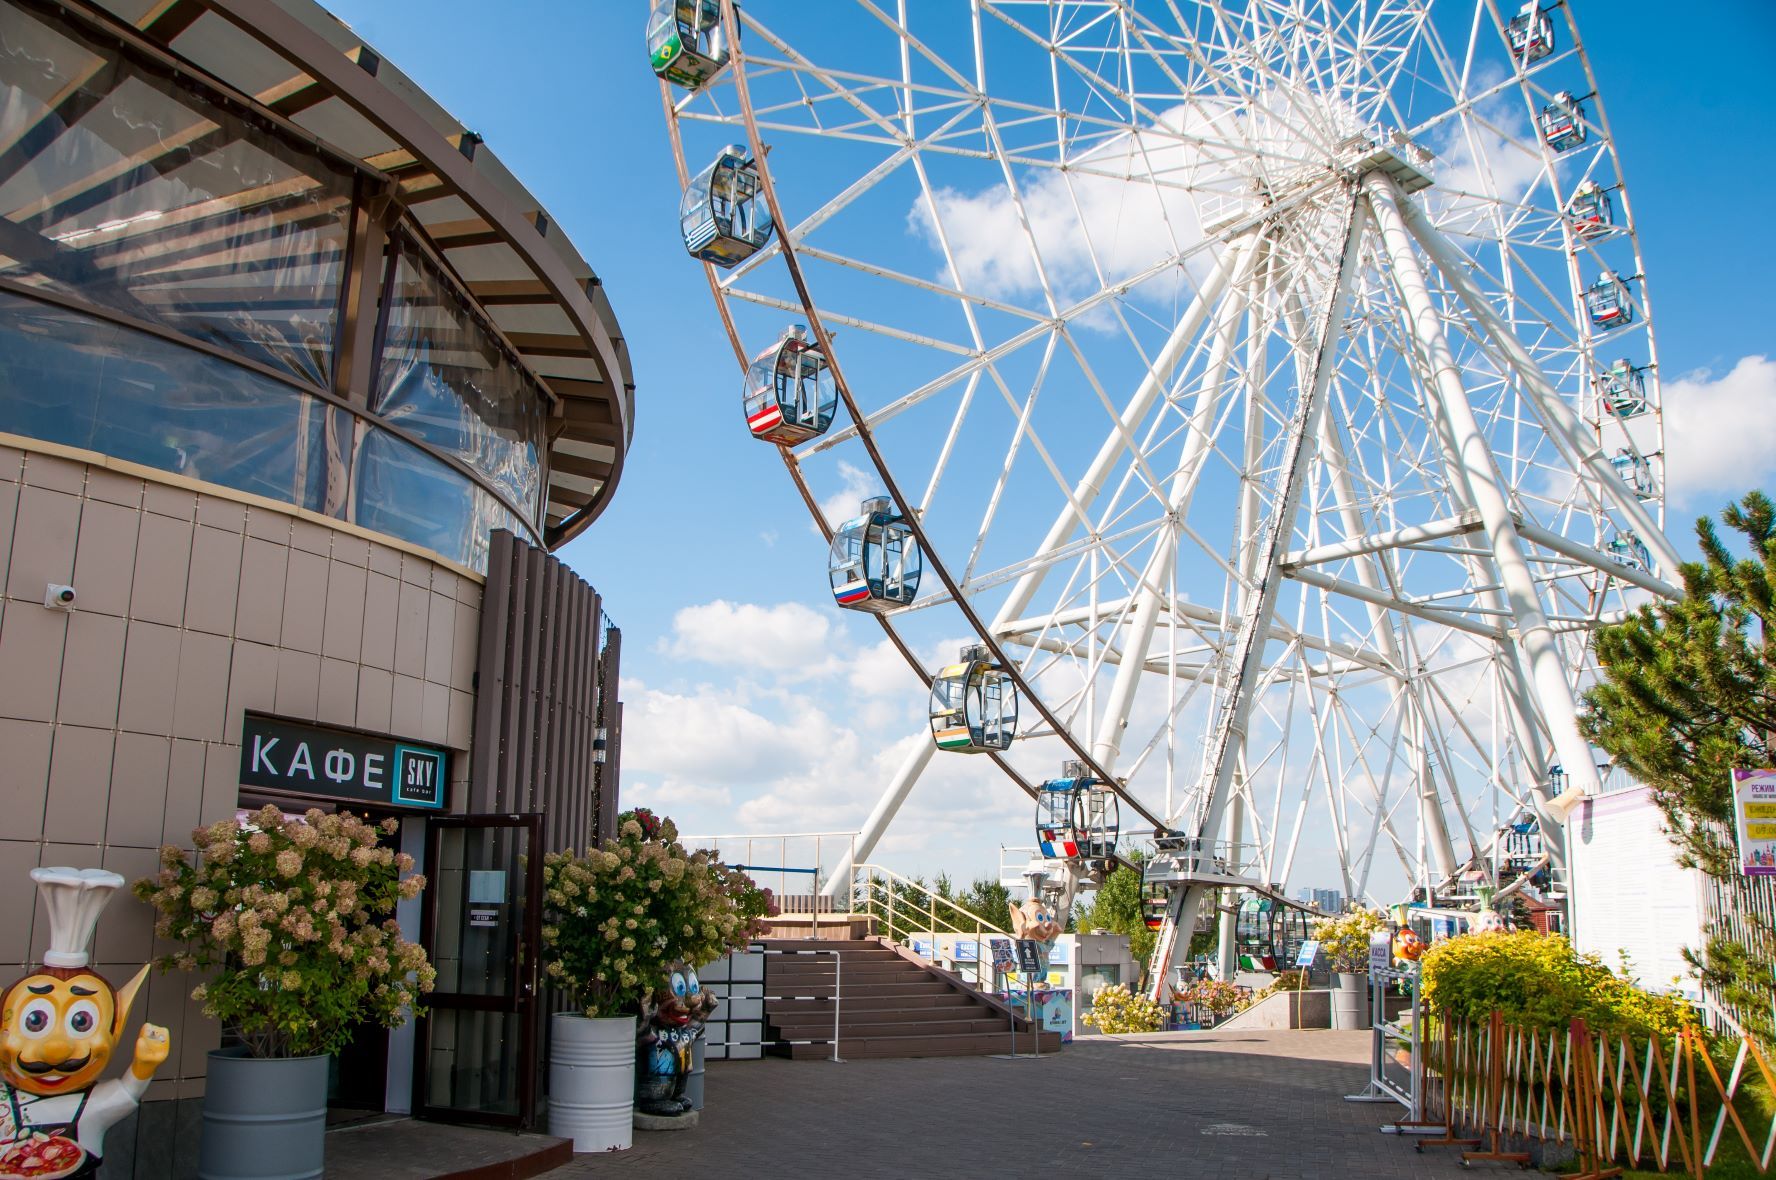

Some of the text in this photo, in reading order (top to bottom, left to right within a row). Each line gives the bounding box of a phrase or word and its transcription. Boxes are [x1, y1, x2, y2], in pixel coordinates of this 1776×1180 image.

[251, 734, 385, 789] КАФЕ
[407, 757, 434, 787] SKY
[1751, 784, 1775, 792] РЕЖИМ
[1371, 947, 1387, 957] КАССА
